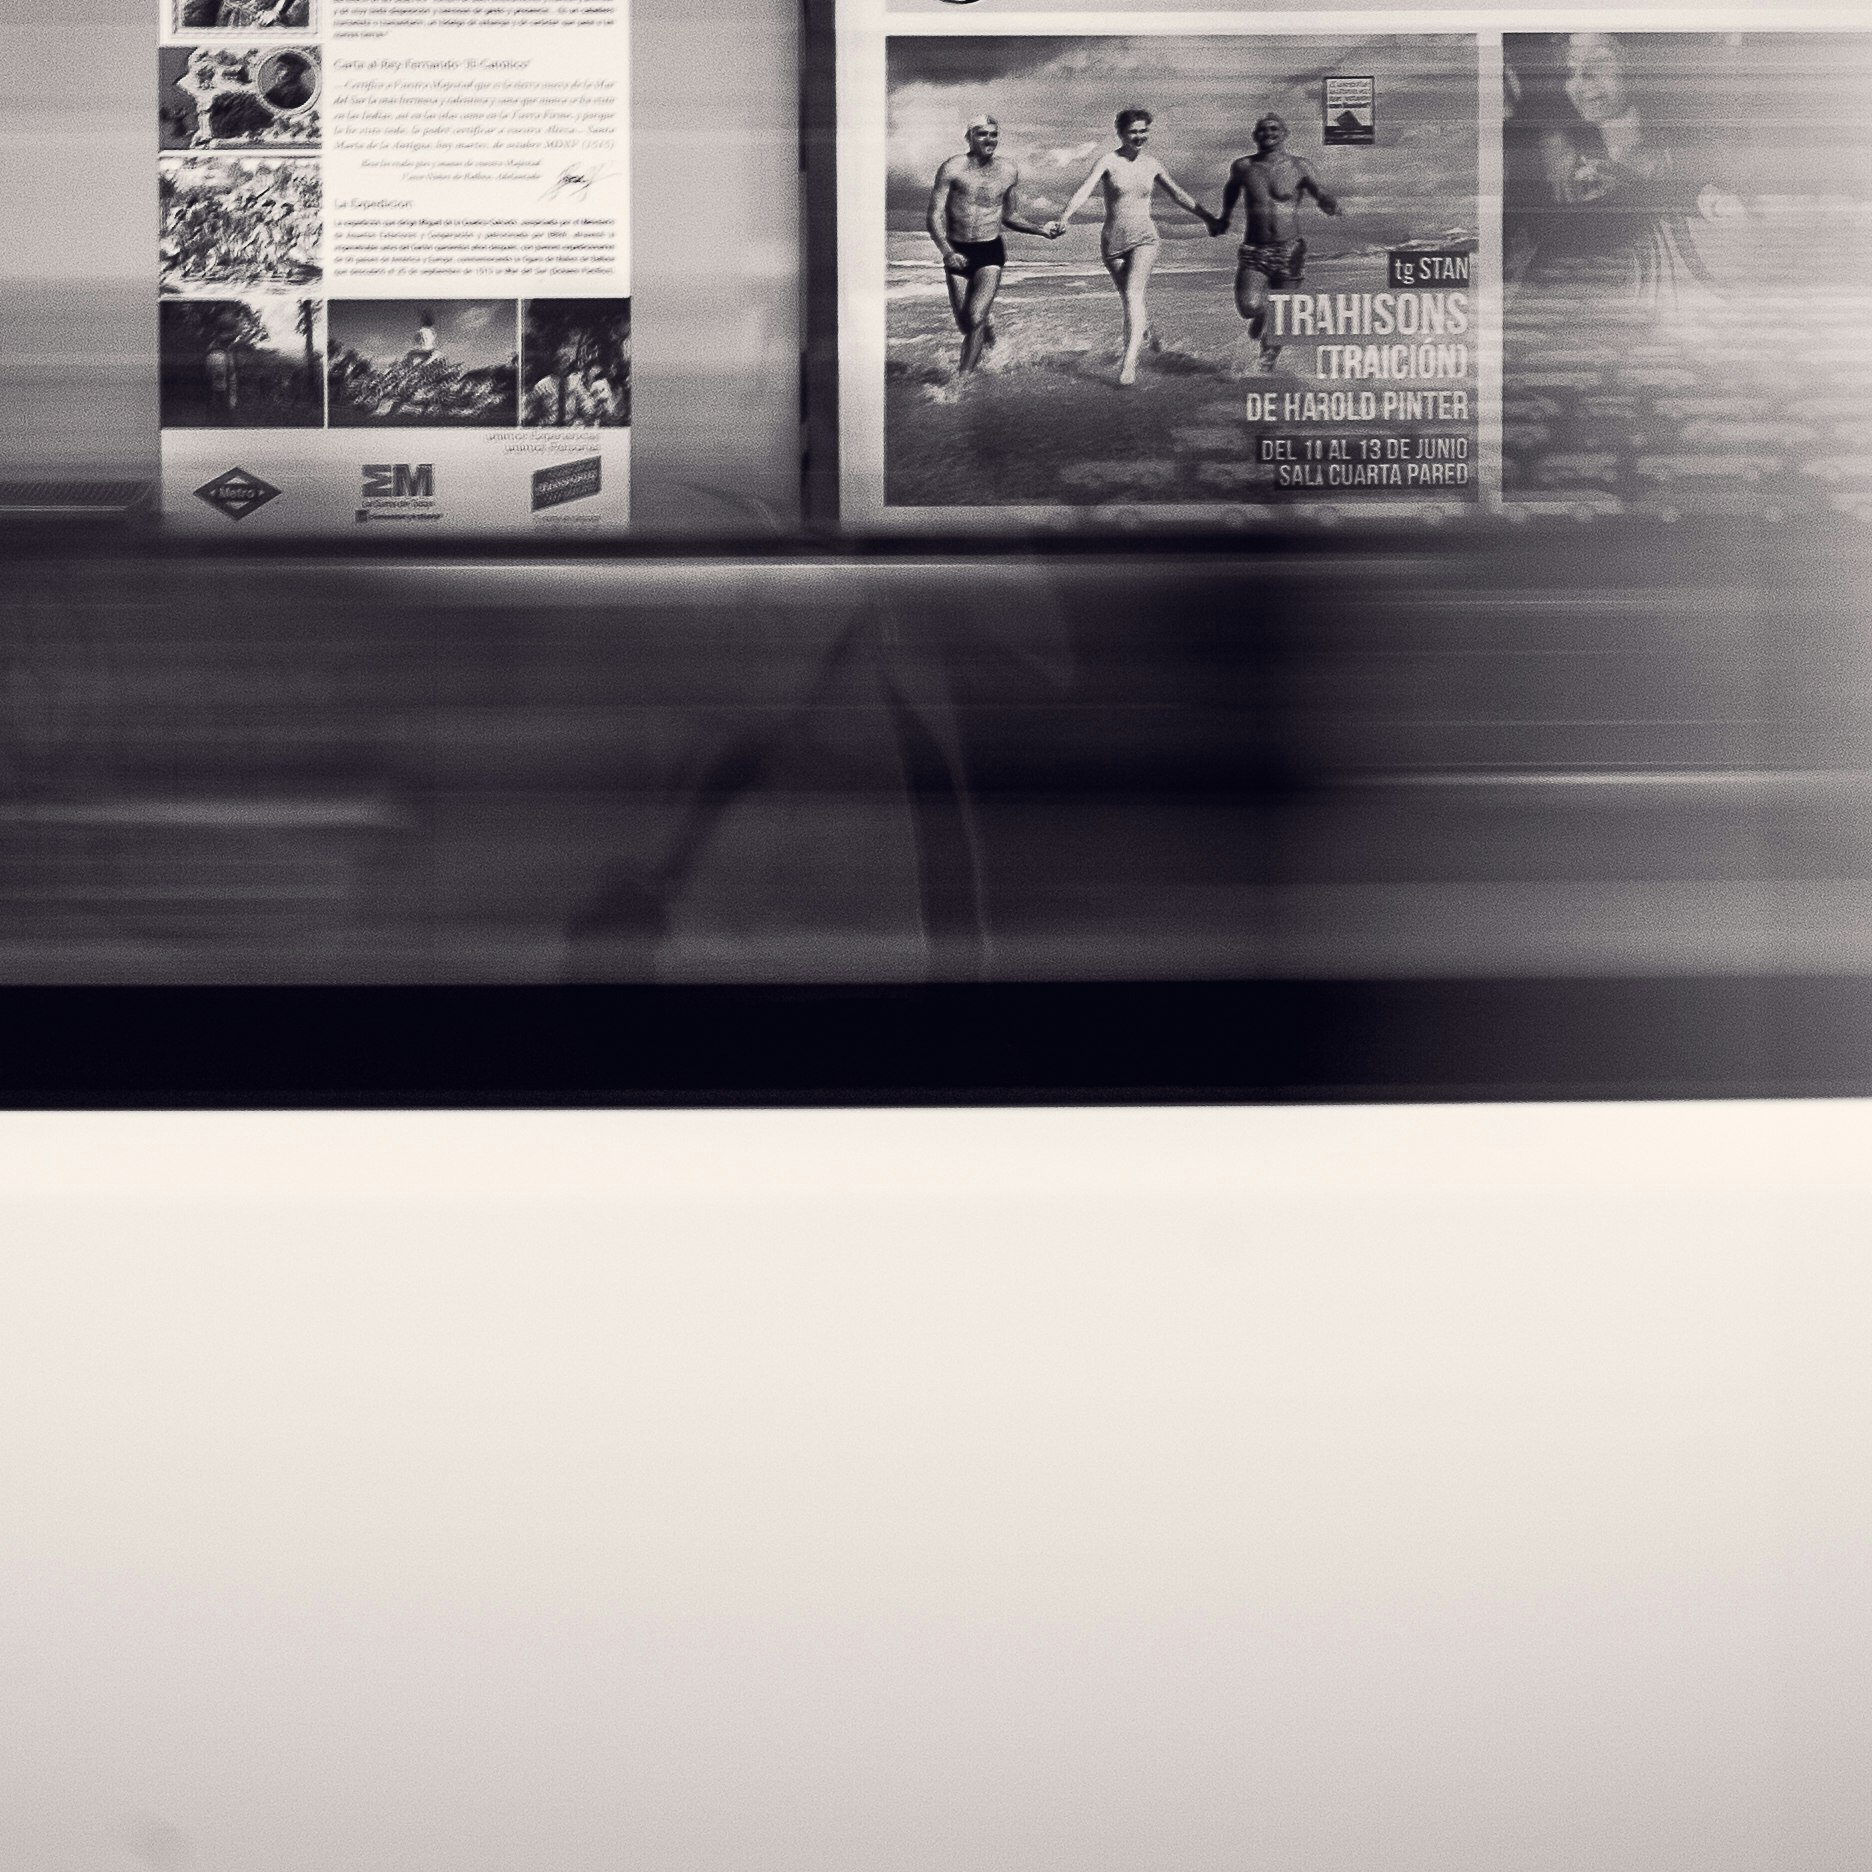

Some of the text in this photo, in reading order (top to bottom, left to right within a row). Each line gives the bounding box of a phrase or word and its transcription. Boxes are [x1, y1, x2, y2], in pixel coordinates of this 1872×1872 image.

[381, 59, 402, 73] Rey
[404, 58, 460, 71] Fernando
[1395, 257, 1469, 284] tg STAN
[1267, 293, 1469, 336] TRAHISONS
[1246, 390, 1469, 421] DE HAROLD PINTER
[1261, 439, 1297, 461] DEL
[1329, 439, 1351, 461] AL
[1359, 439, 1382, 461] 13
[1386, 438, 1411, 460] DE
[1415, 437, 1469, 460] JUNIO
[1279, 463, 1469, 487] SALA CUARTA PARED
[218, 483, 256, 499] Metro
